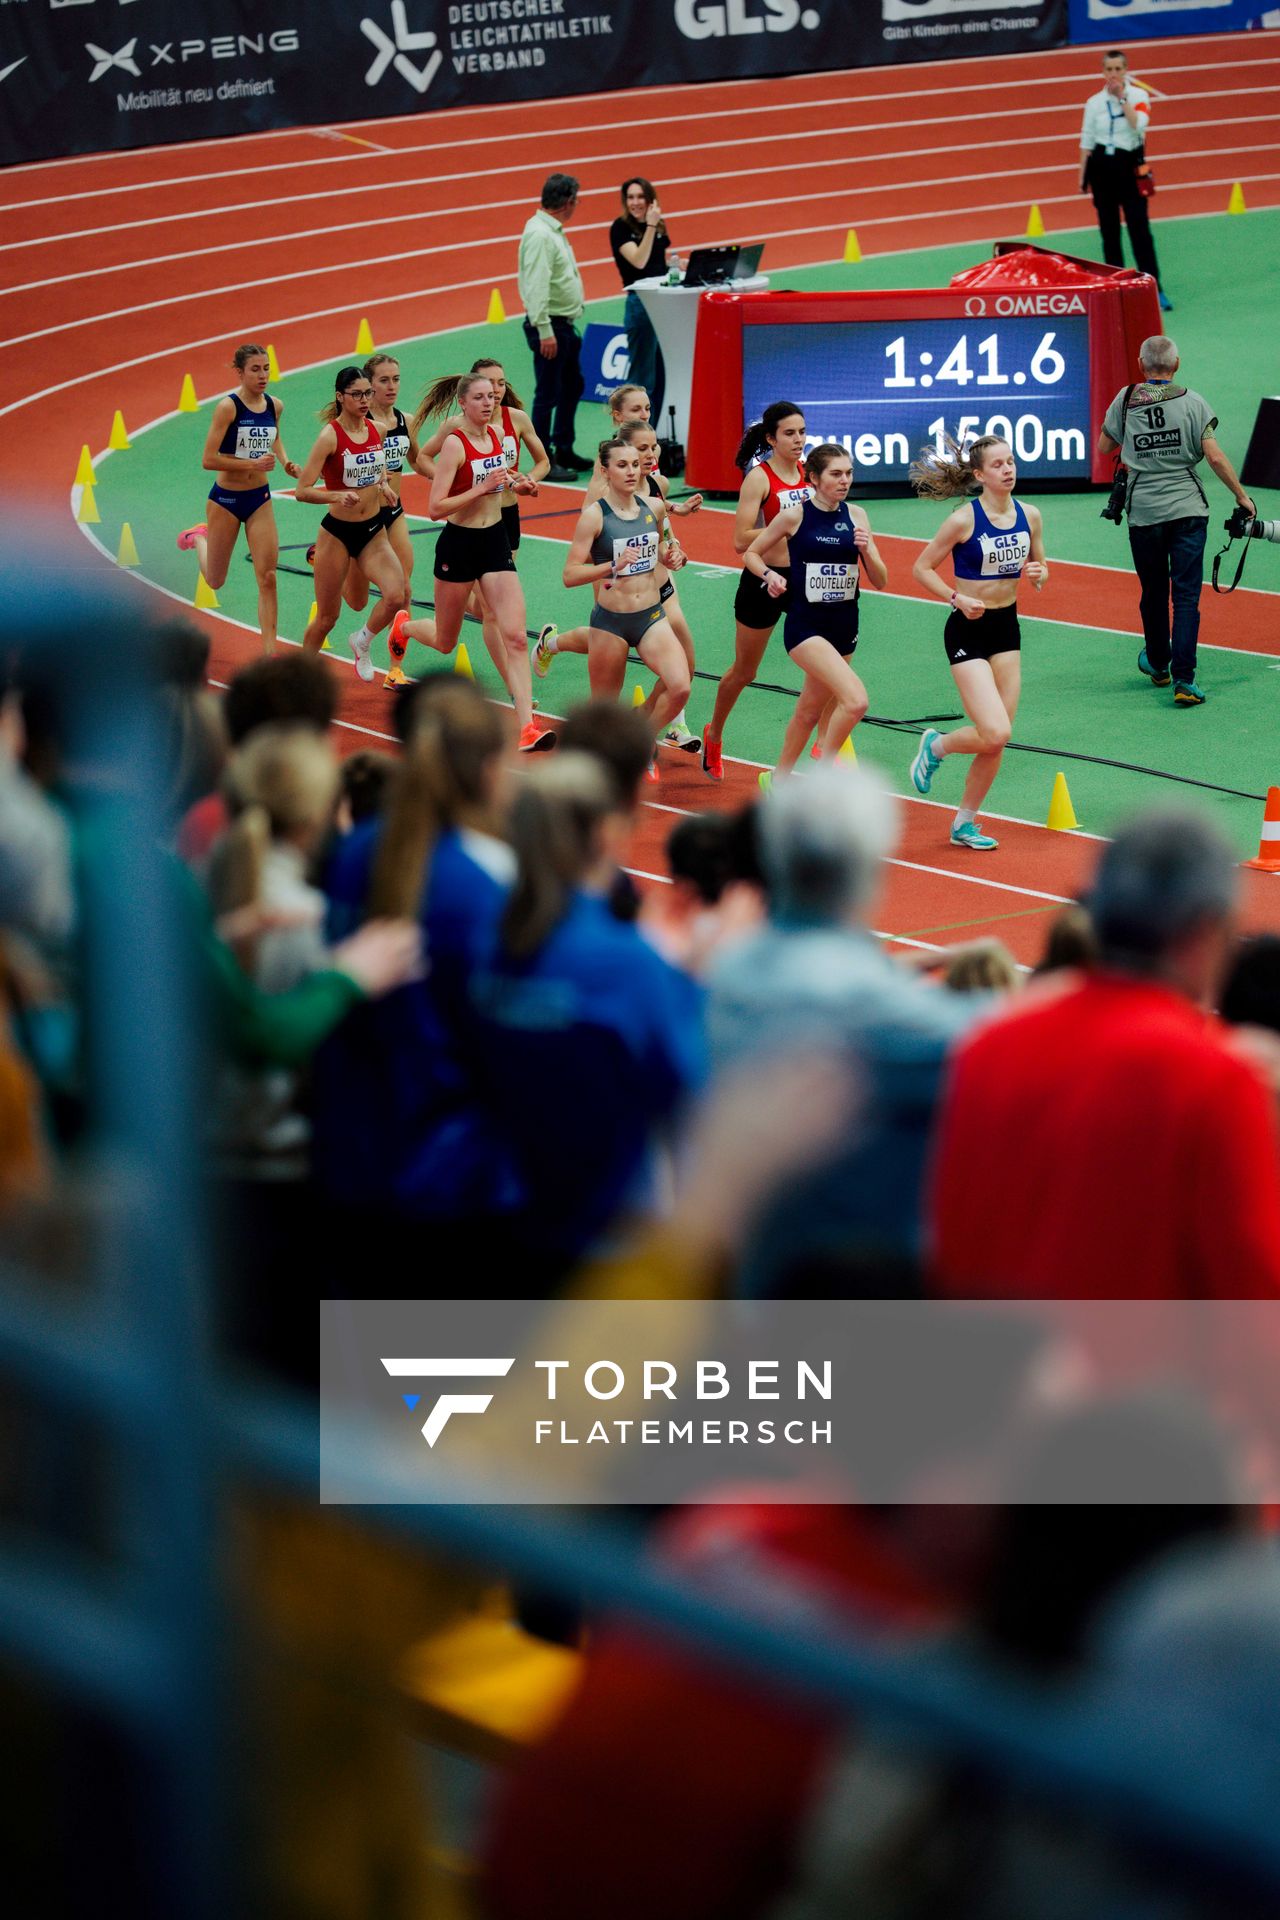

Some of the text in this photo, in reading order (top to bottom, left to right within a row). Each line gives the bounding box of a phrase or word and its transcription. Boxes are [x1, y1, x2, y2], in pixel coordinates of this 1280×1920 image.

[448, 0, 565, 24] DEUTSCHER
[991, 17, 1039, 31] Chance
[450, 15, 613, 50] LEICHTATHLETIK
[149, 29, 300, 66] XPENG
[452, 47, 546, 74] VERBAND
[117, 77, 276, 112] Mobilität neu definiert
[995, 294, 1086, 316] OMEGA
[883, 332, 1066, 388] 1:41.6
[1144, 407, 1165, 429] 18
[249, 428, 269, 437] GLS
[1153, 433, 1179, 443] PLAN
[356, 453, 376, 464] GLS
[483, 456, 502, 469] GLS
[346, 466, 366, 478] WOLFF
[789, 489, 809, 501] GLS
[626, 535, 649, 547] GLS
[994, 535, 1018, 549] GLS
[989, 546, 1026, 563] BUDDE
[820, 565, 847, 576] GLS
[810, 577, 855, 589] COUTELLIER
